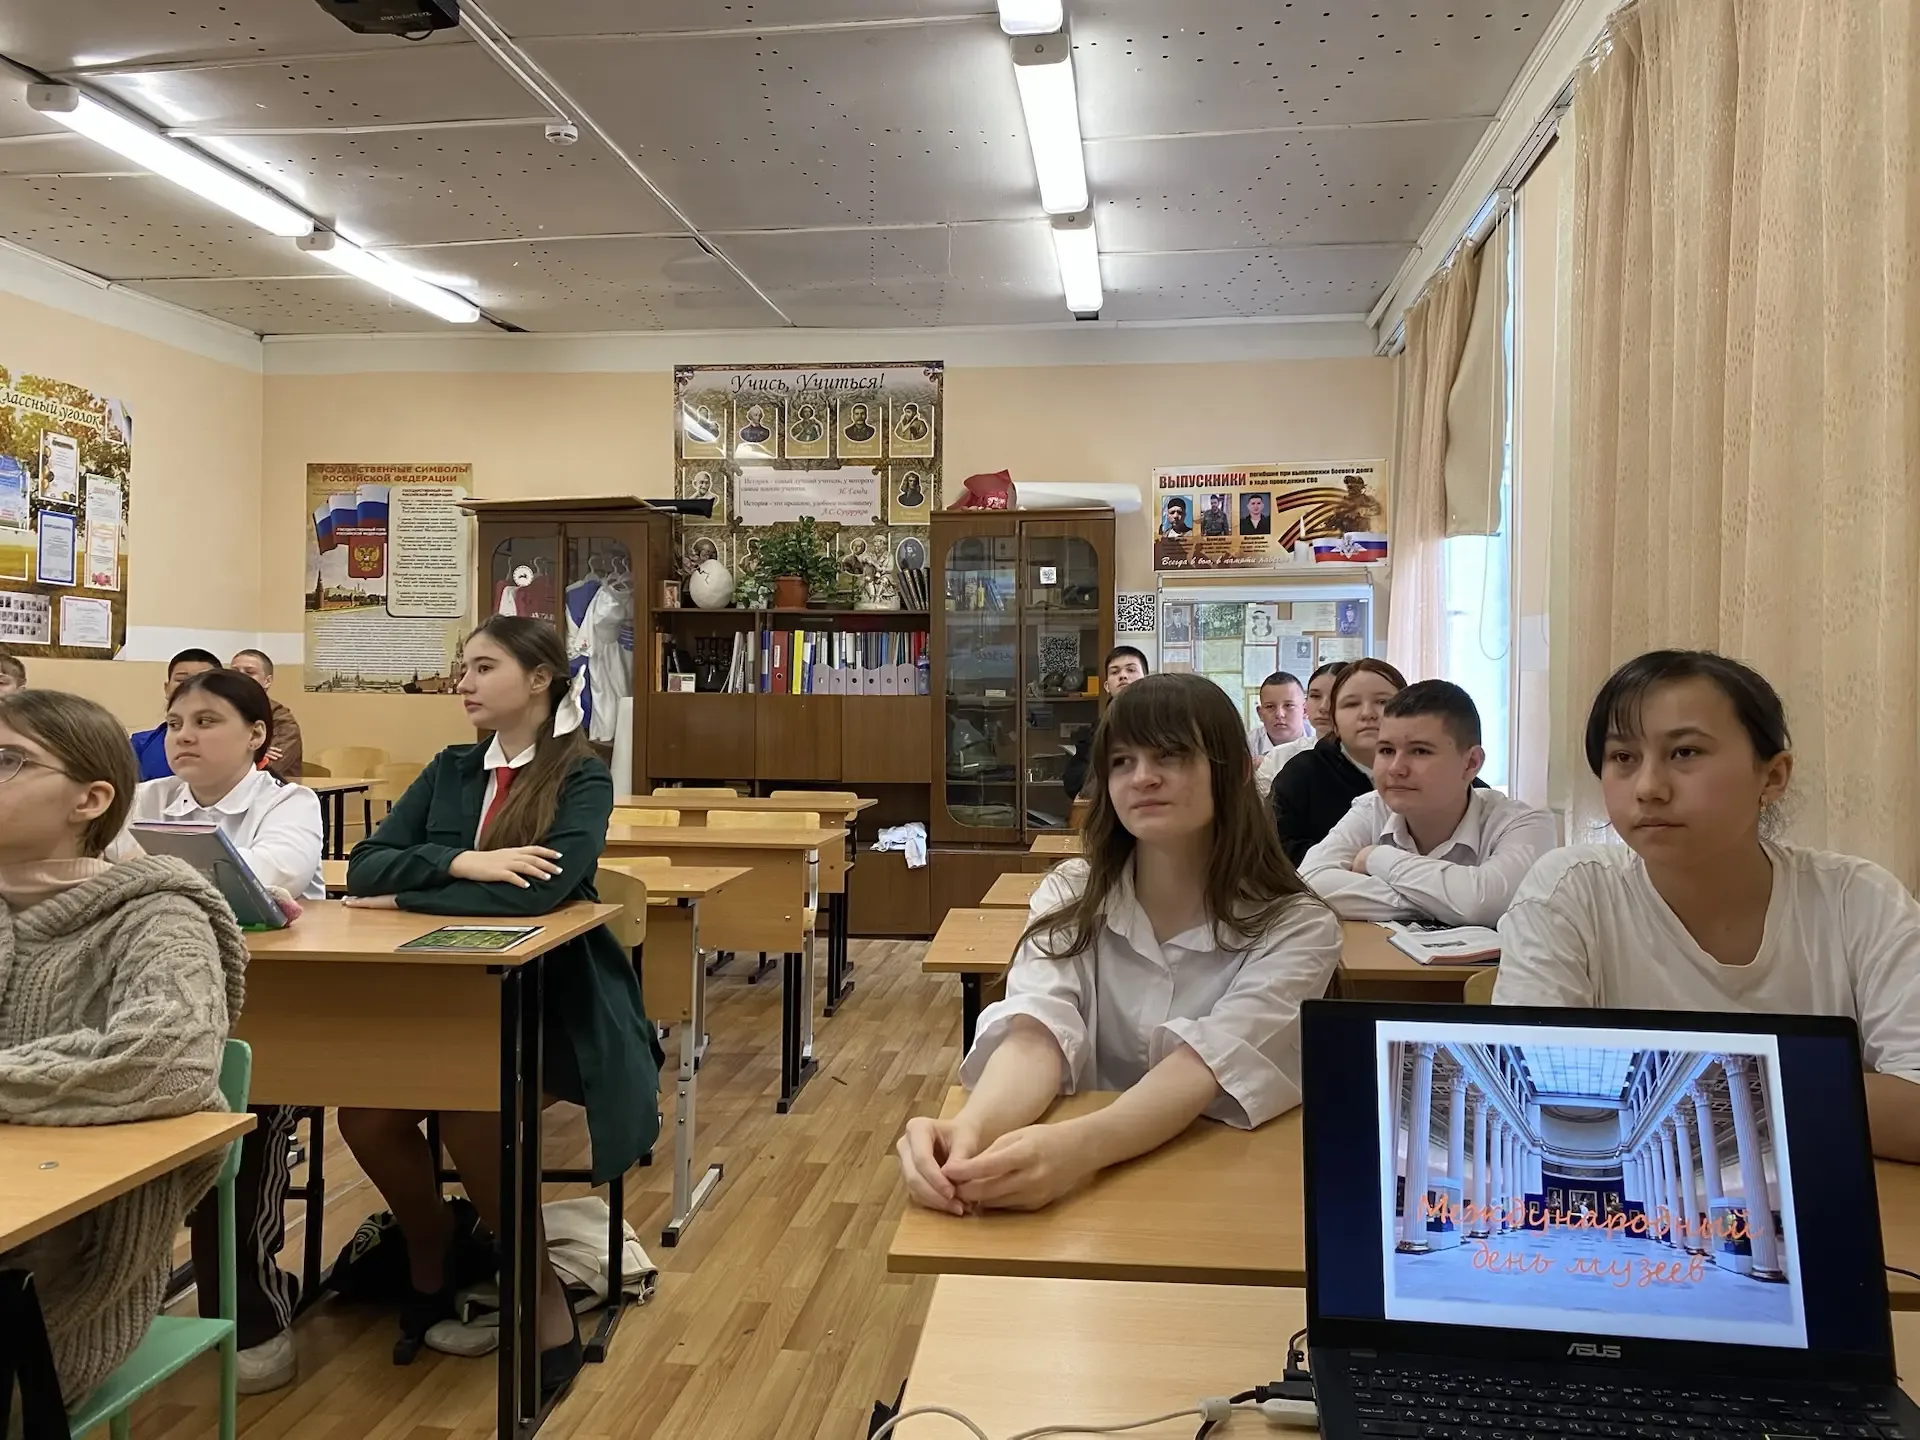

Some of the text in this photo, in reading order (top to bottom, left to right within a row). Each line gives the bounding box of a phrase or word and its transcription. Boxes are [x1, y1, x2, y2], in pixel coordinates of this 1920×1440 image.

[731, 373, 885, 394] Учись, Учиться!
[59, 407, 103, 431] уголок
[323, 474, 457, 483] РОССИЙСКОЙ ФЕДЕРАЦИИ
[1159, 472, 1247, 489] ВЫПУСКНИКИ
[1161, 556, 1188, 568] Всегда
[1417, 1194, 1766, 1240] Международный
[1473, 1240, 1705, 1288] день музеев
[1565, 1343, 1622, 1359] ASUS
